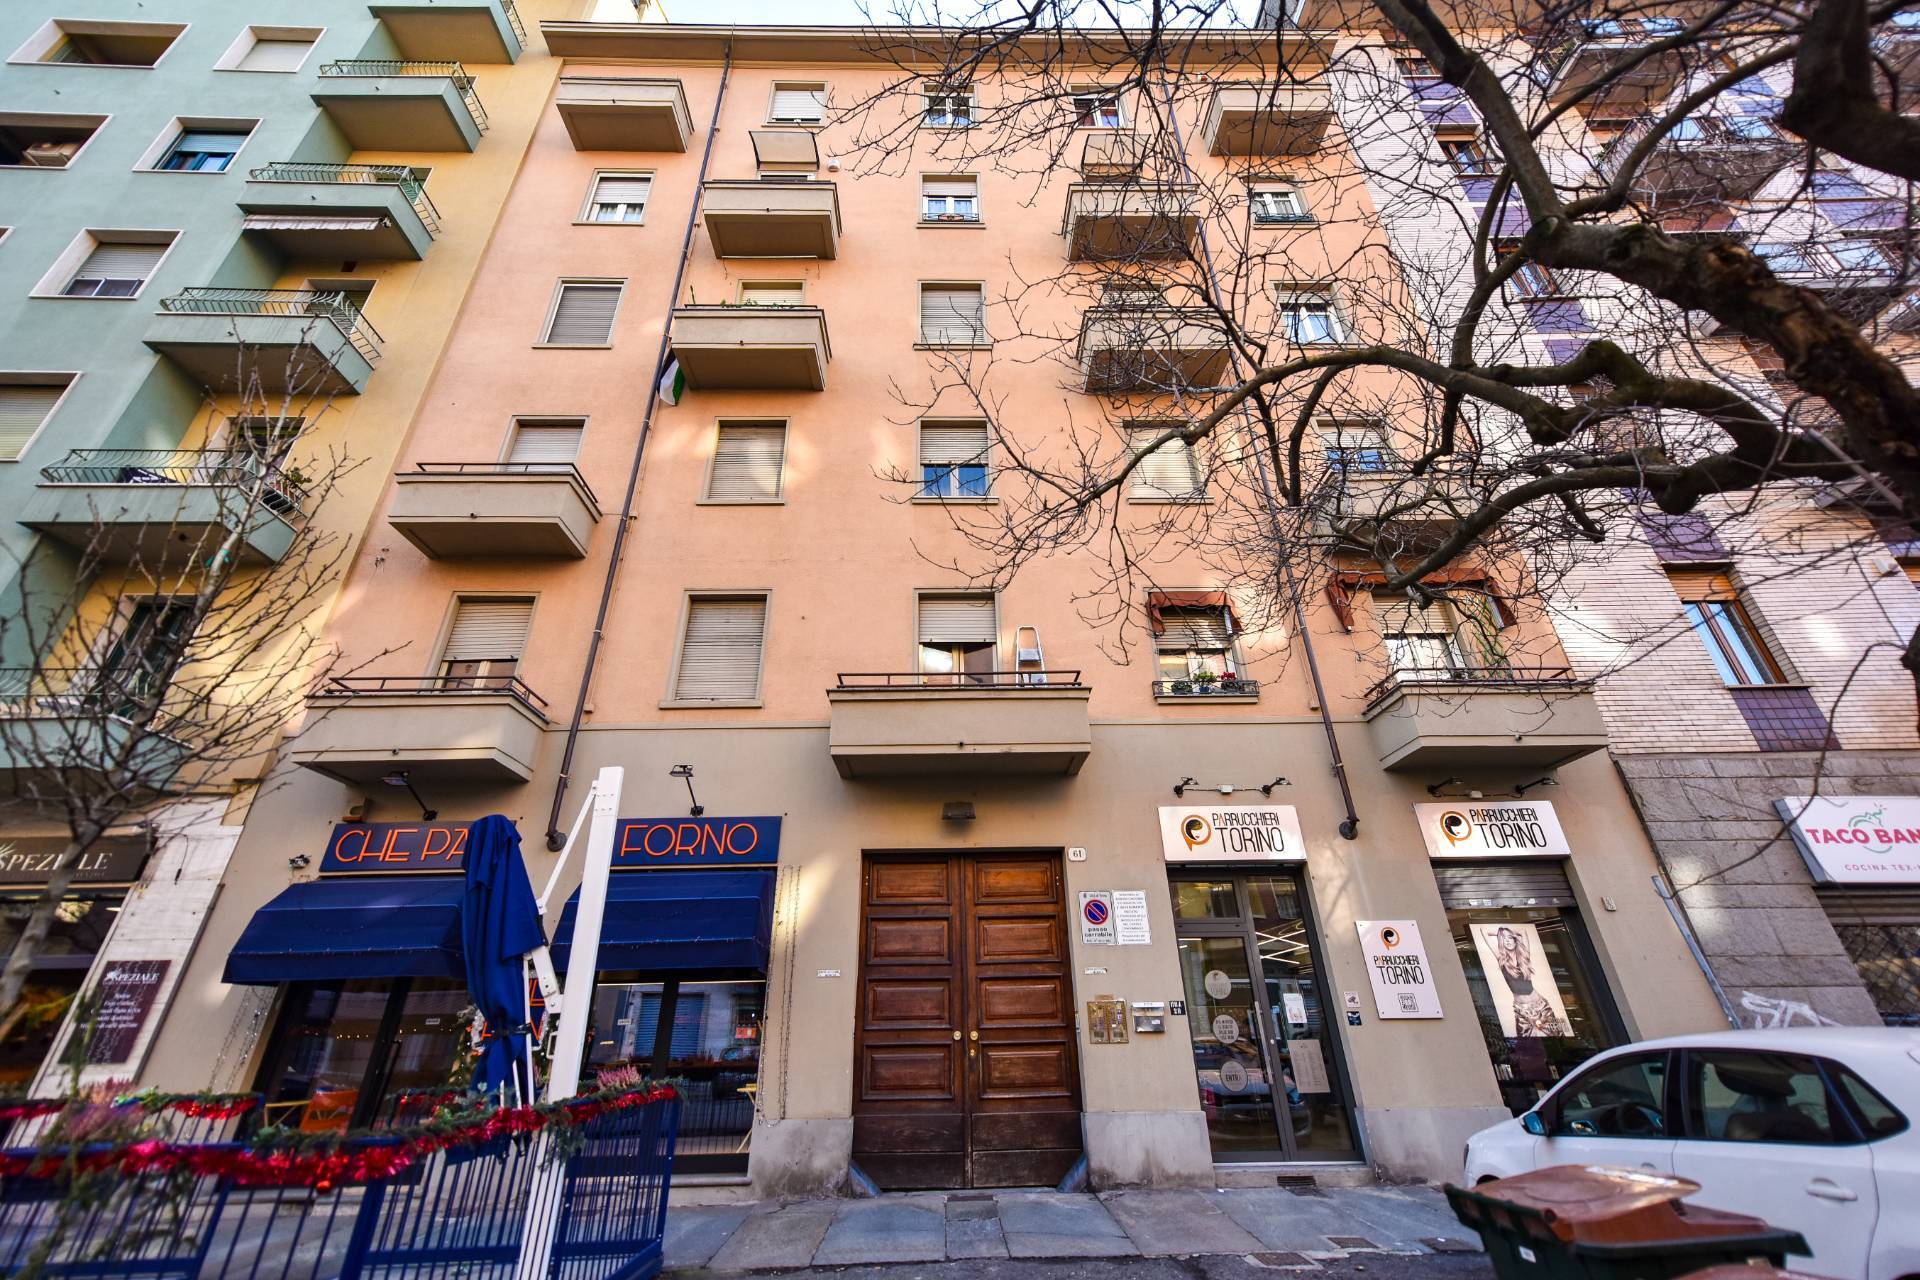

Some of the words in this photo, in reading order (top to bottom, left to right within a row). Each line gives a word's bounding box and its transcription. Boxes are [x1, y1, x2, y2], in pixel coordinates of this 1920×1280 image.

[1212, 812, 1280, 827] PARRUCCHIERI
[1469, 808, 1538, 823] PARRUCCHIERI
[620, 823, 758, 857] FORNO
[1215, 827, 1285, 852] TORINO
[1474, 823, 1547, 848] TORINO
[1805, 828, 1870, 844] TACO
[335, 829, 418, 862] CHE
[1073, 849, 1082, 858] 61
[1373, 955, 1420, 966] PARRUCCHIERI
[1376, 965, 1425, 985] TORINO
